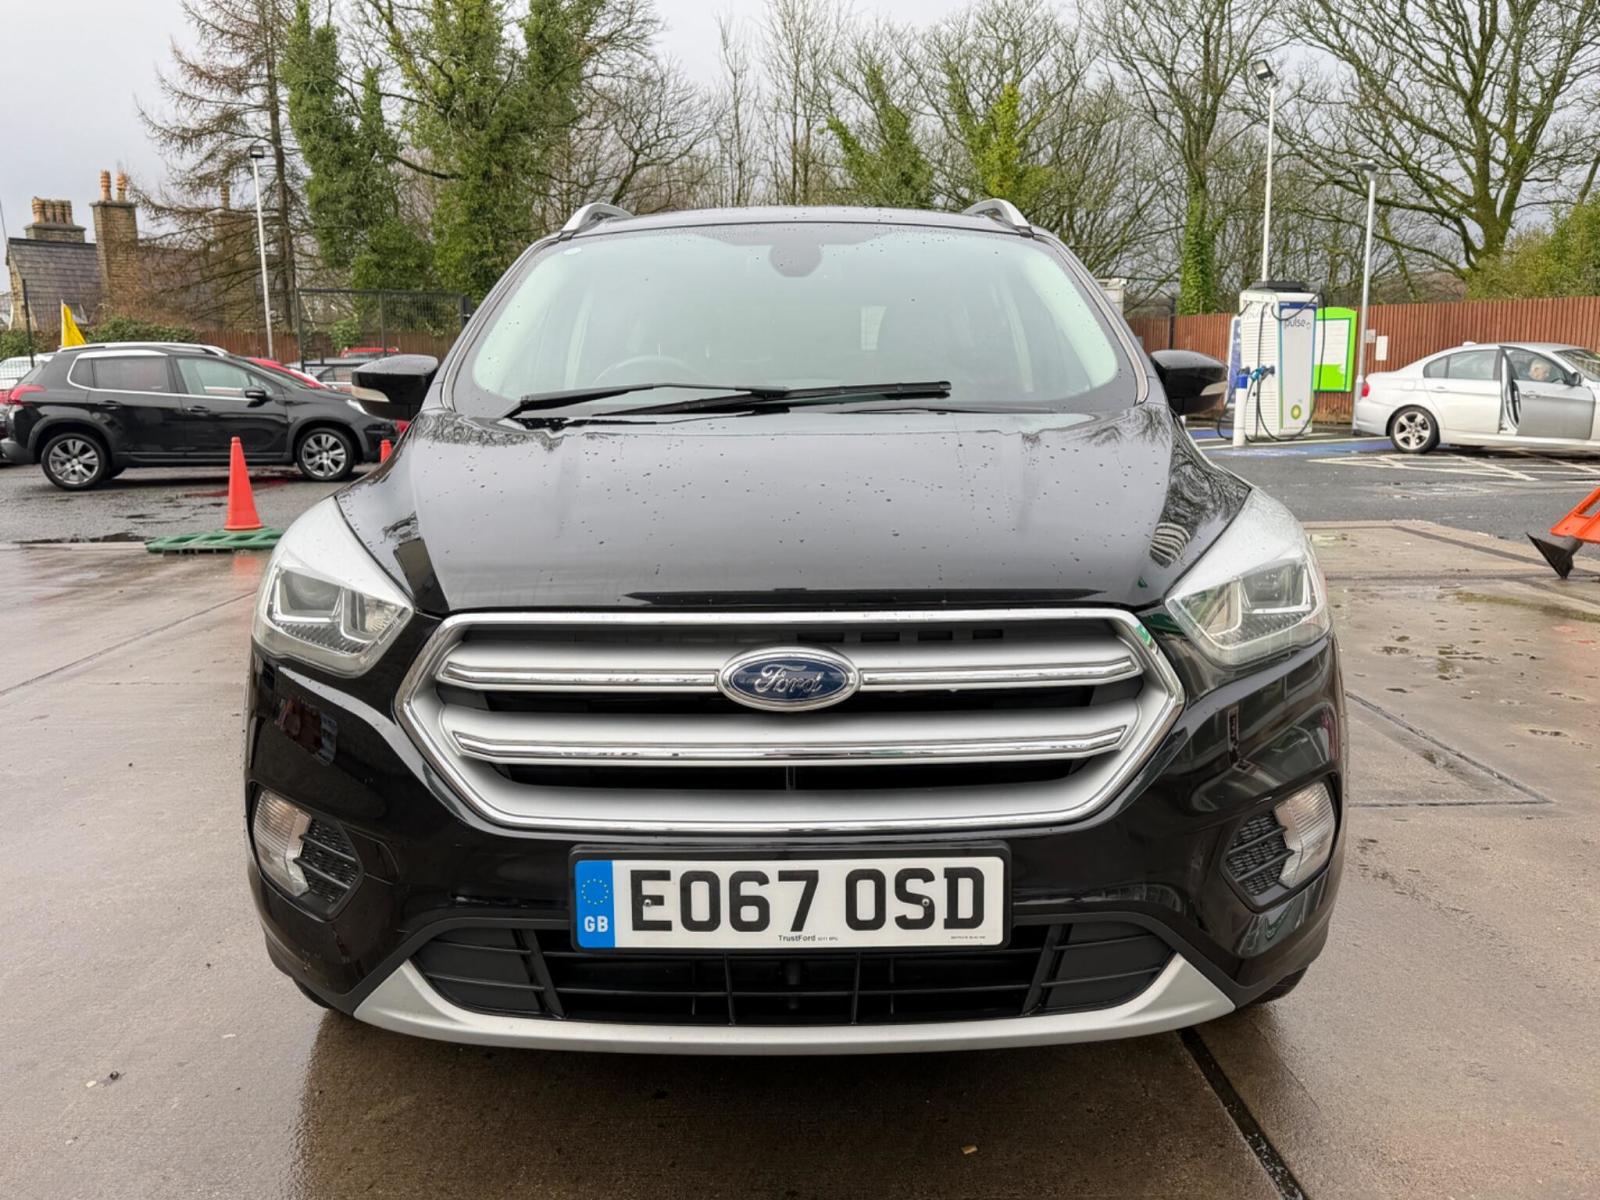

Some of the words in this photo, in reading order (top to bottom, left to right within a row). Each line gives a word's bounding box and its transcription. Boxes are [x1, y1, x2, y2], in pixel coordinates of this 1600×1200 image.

[754, 664, 825, 693] Ford
[630, 870, 820, 932] EO67
[845, 867, 985, 931] OSD
[584, 915, 609, 932] GB
[777, 934, 816, 942] TrustFord
